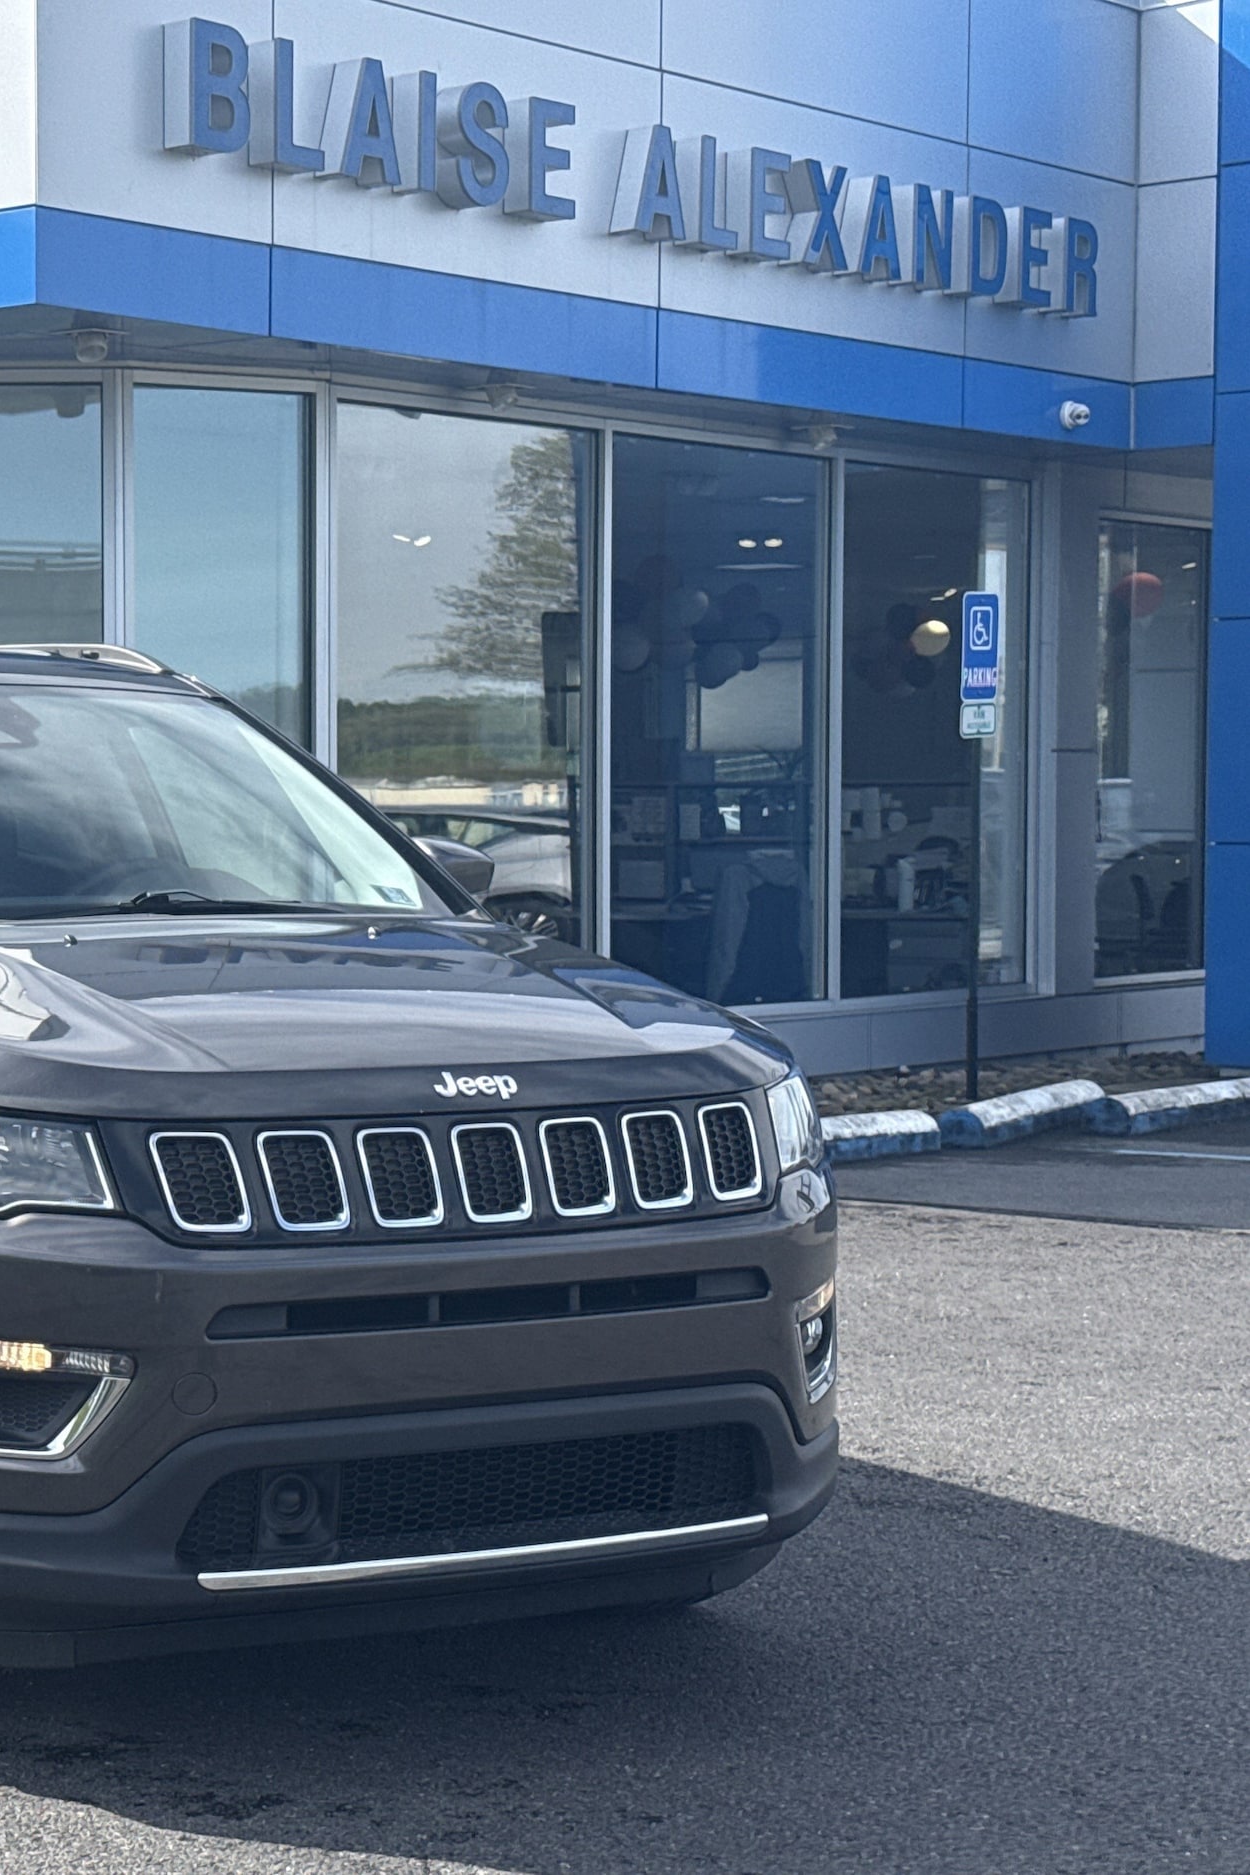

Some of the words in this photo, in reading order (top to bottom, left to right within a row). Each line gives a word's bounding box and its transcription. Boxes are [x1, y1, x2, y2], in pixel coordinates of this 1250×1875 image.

[162, 17, 576, 222] BLAISE
[608, 124, 1098, 318] ALEXANDER
[963, 667, 997, 688] PARKING
[433, 1071, 518, 1100] Jeep
